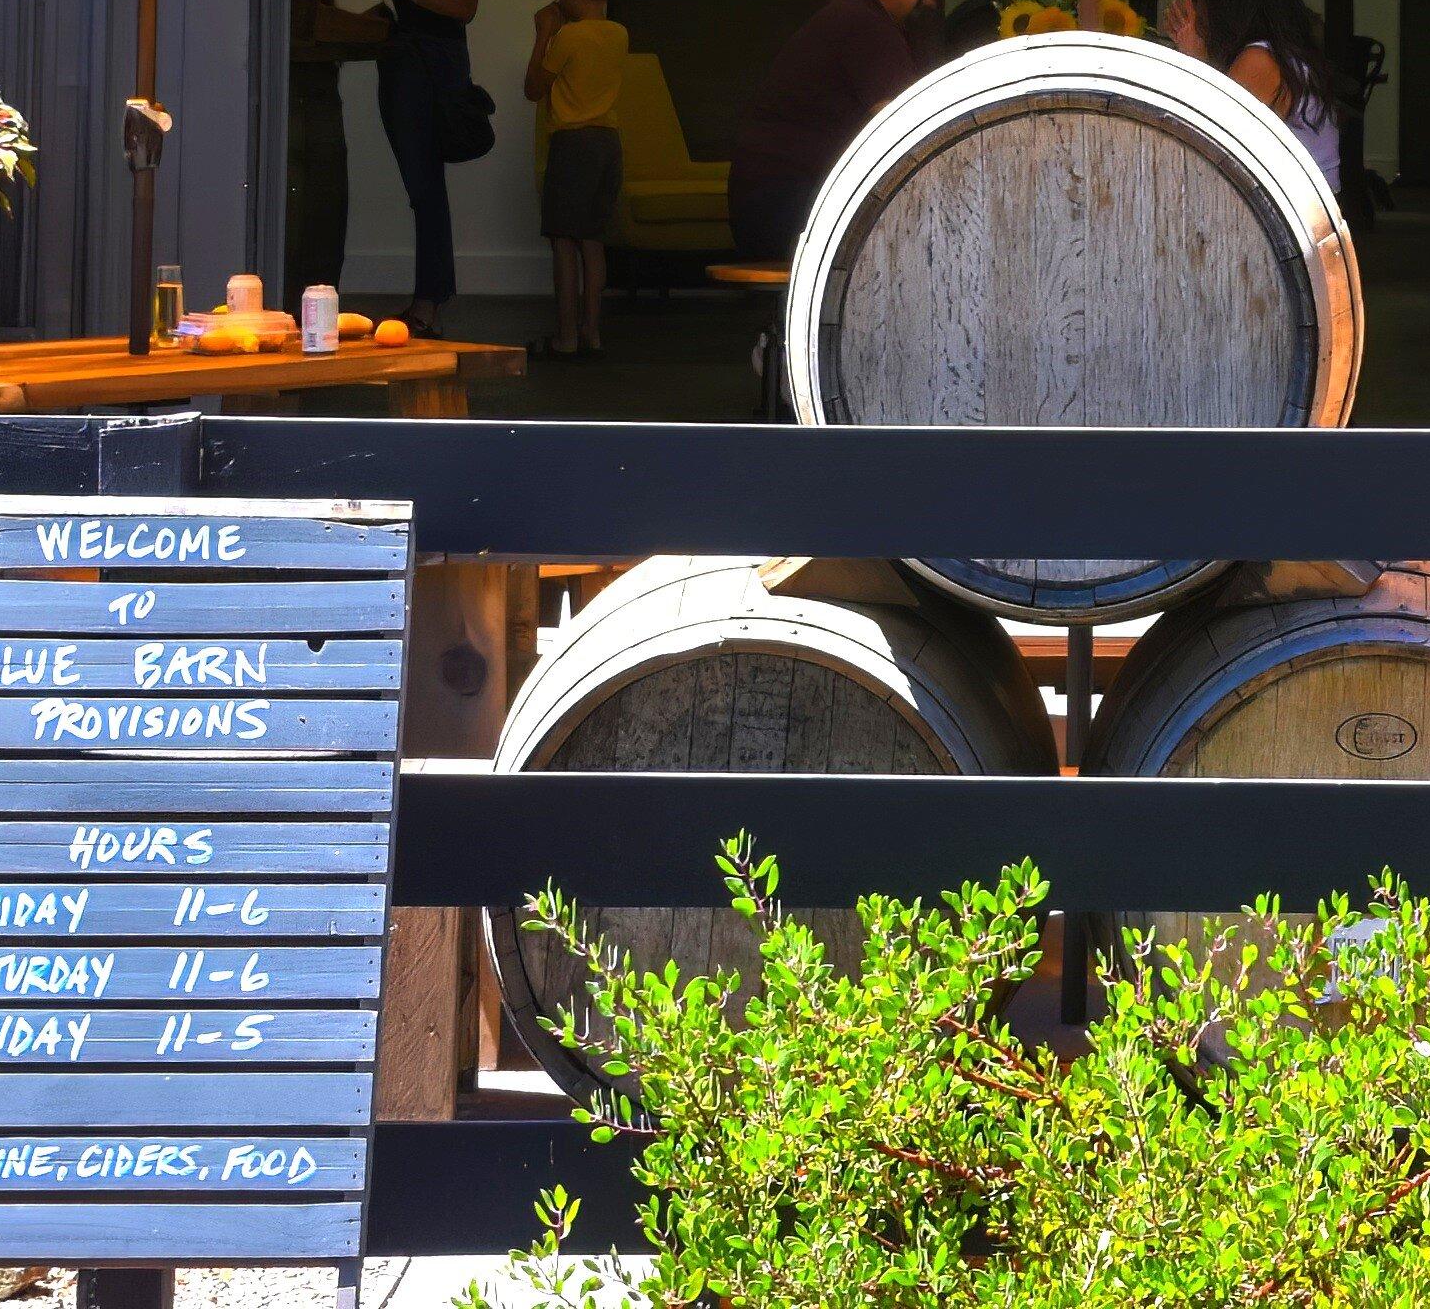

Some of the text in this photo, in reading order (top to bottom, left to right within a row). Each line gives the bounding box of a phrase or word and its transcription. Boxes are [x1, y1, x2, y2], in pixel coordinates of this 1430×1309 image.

[36, 519, 248, 563] WELCOME
[107, 589, 156, 627] TO
[132, 639, 268, 690] BARN
[28, 697, 272, 741] PROVISIONS
[68, 825, 214, 871] HOURS
[173, 886, 274, 928] 11-6
[167, 950, 271, 994] 11-6
[156, 1011, 274, 1056] 11-5
[220, 1145, 317, 1187] FOOD
